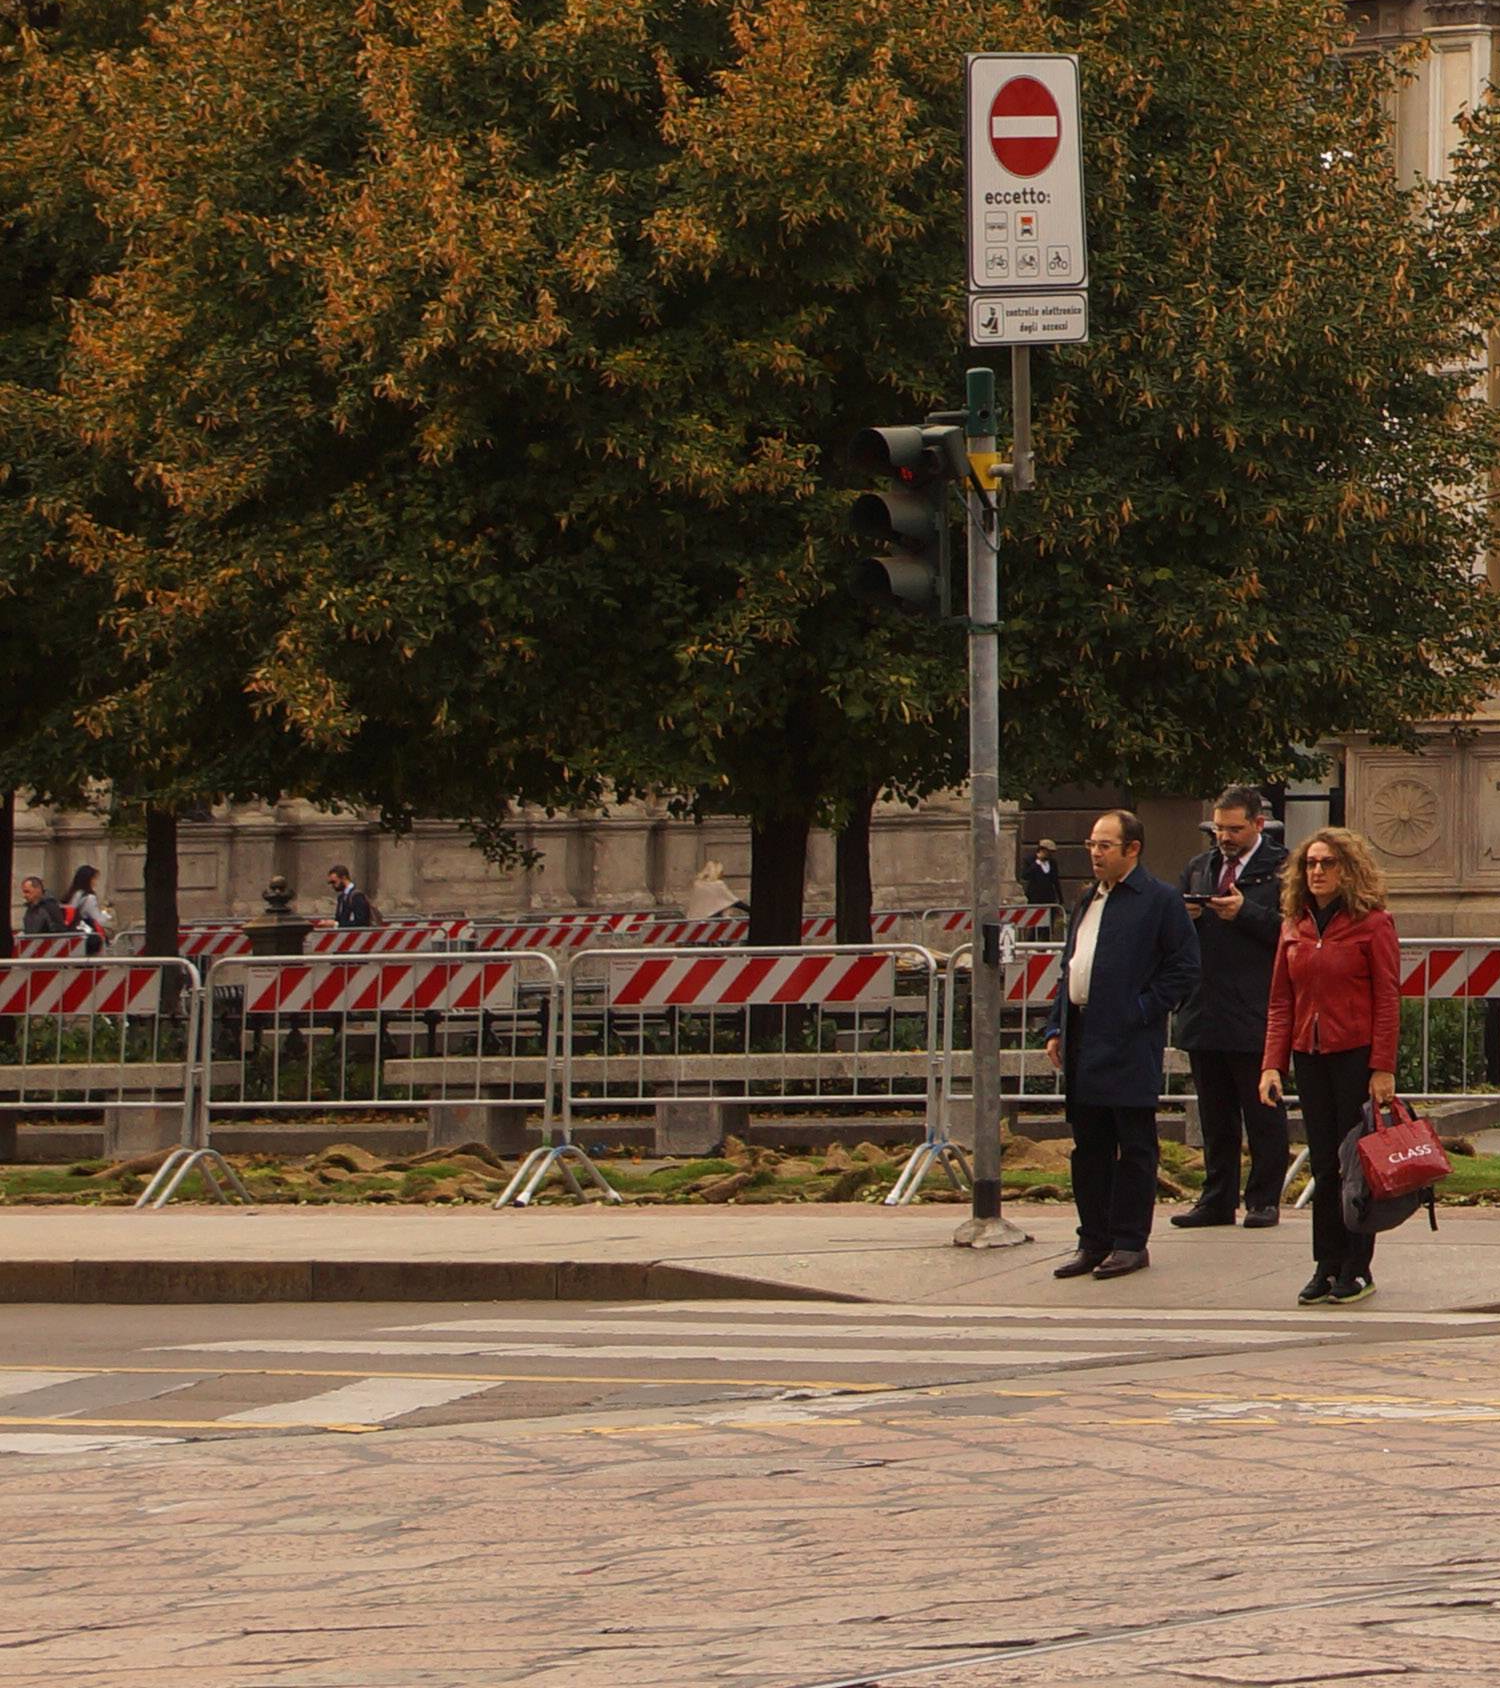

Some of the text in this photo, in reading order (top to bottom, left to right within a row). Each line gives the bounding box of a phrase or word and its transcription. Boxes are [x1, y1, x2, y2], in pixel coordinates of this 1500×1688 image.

[985, 187, 1051, 205] eccetto:
[1006, 305, 1082, 317] controllo elettronico
[1020, 321, 1068, 333] degli accessi
[1388, 1143, 1432, 1164] CLASS
